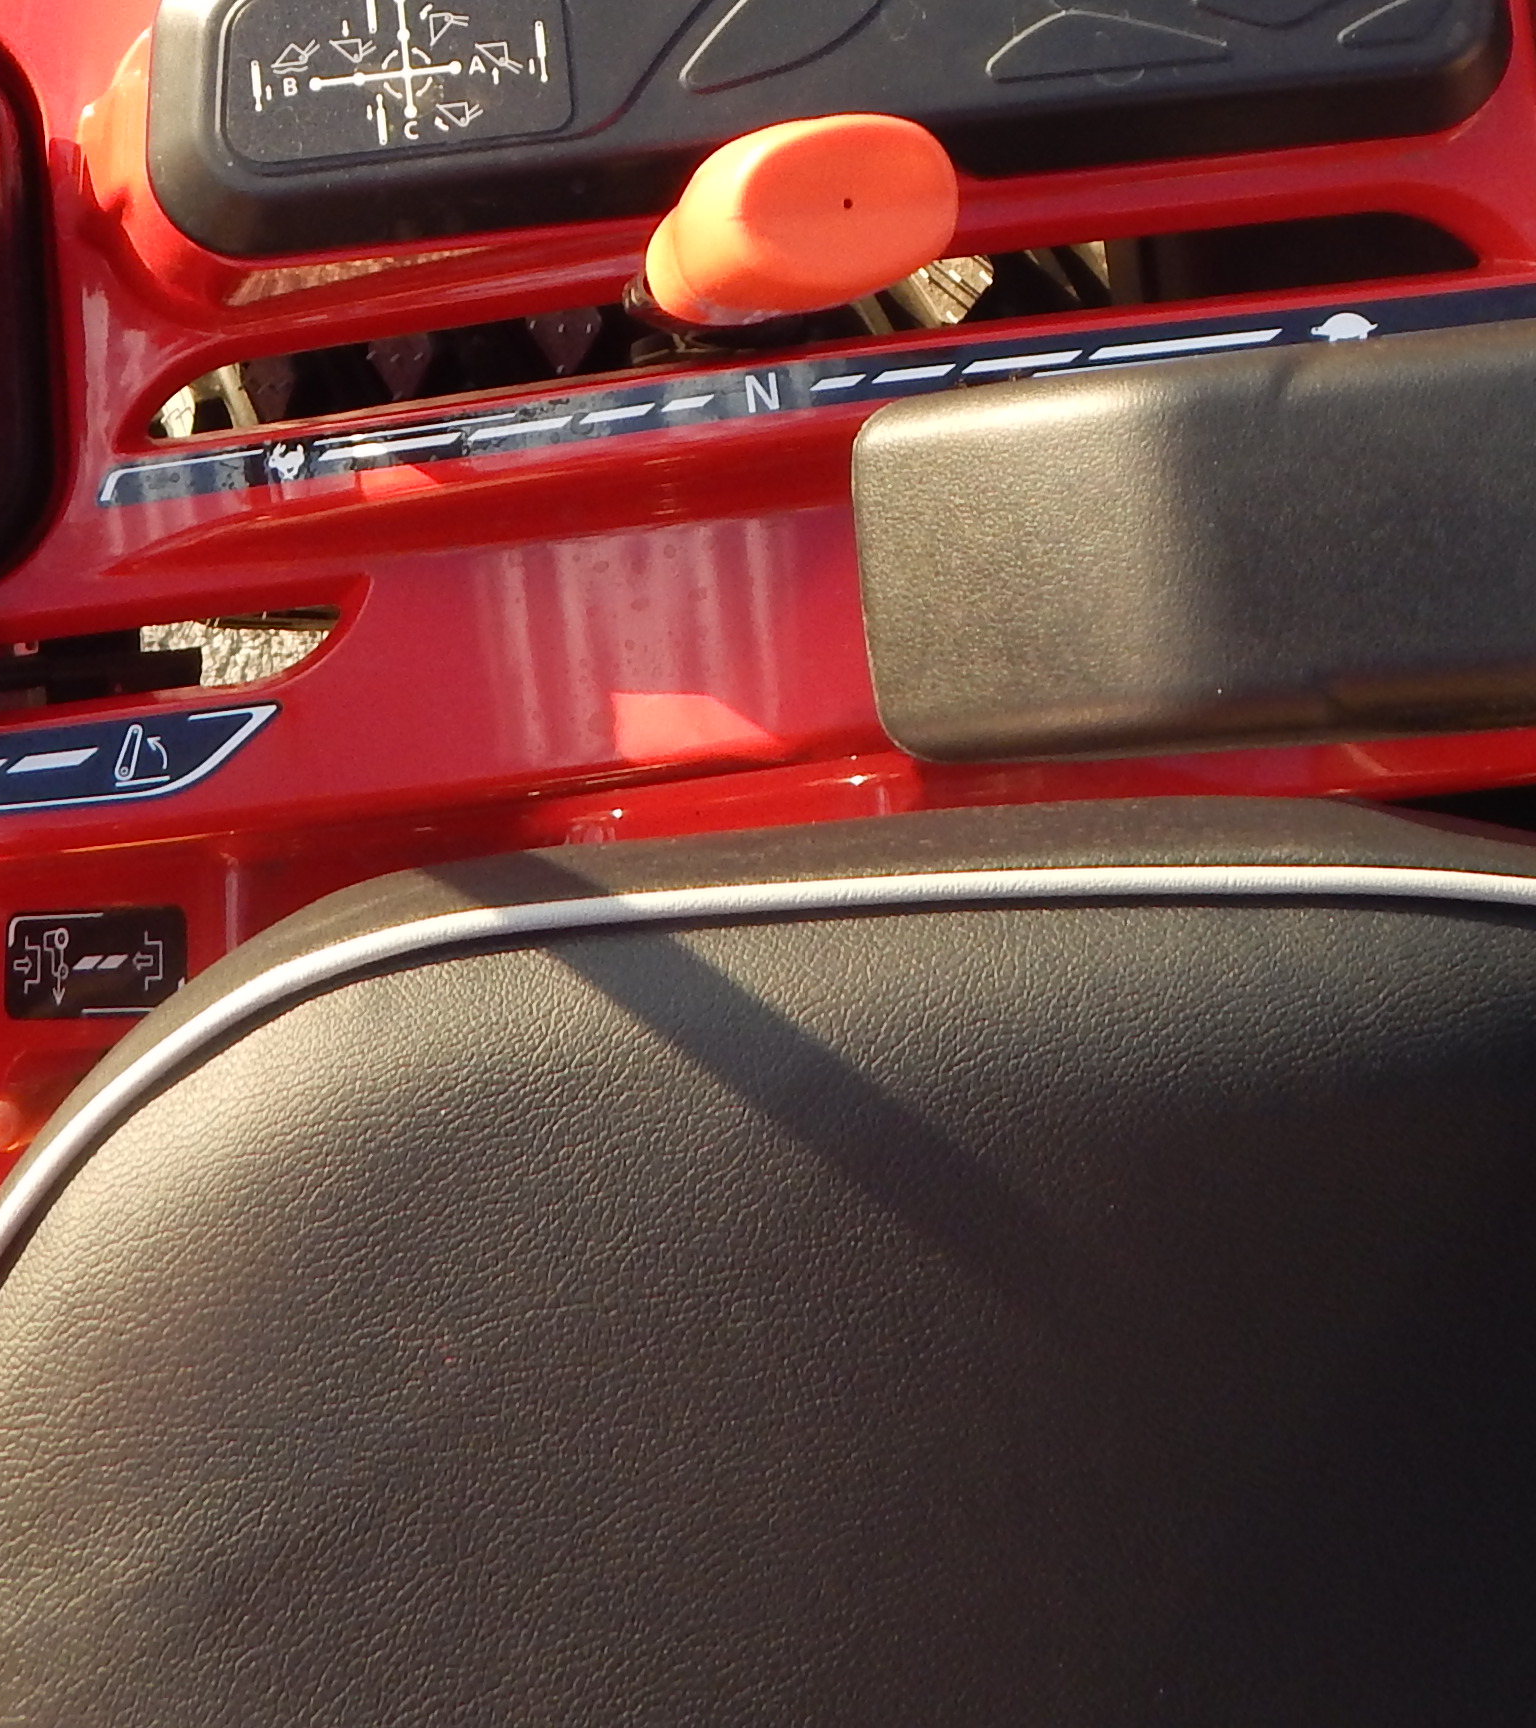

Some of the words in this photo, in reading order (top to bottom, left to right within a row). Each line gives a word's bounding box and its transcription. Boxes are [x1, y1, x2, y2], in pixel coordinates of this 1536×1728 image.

[469, 55, 486, 75] A
[283, 77, 298, 97] B
[404, 120, 420, 140] C
[745, 372, 780, 414] N
